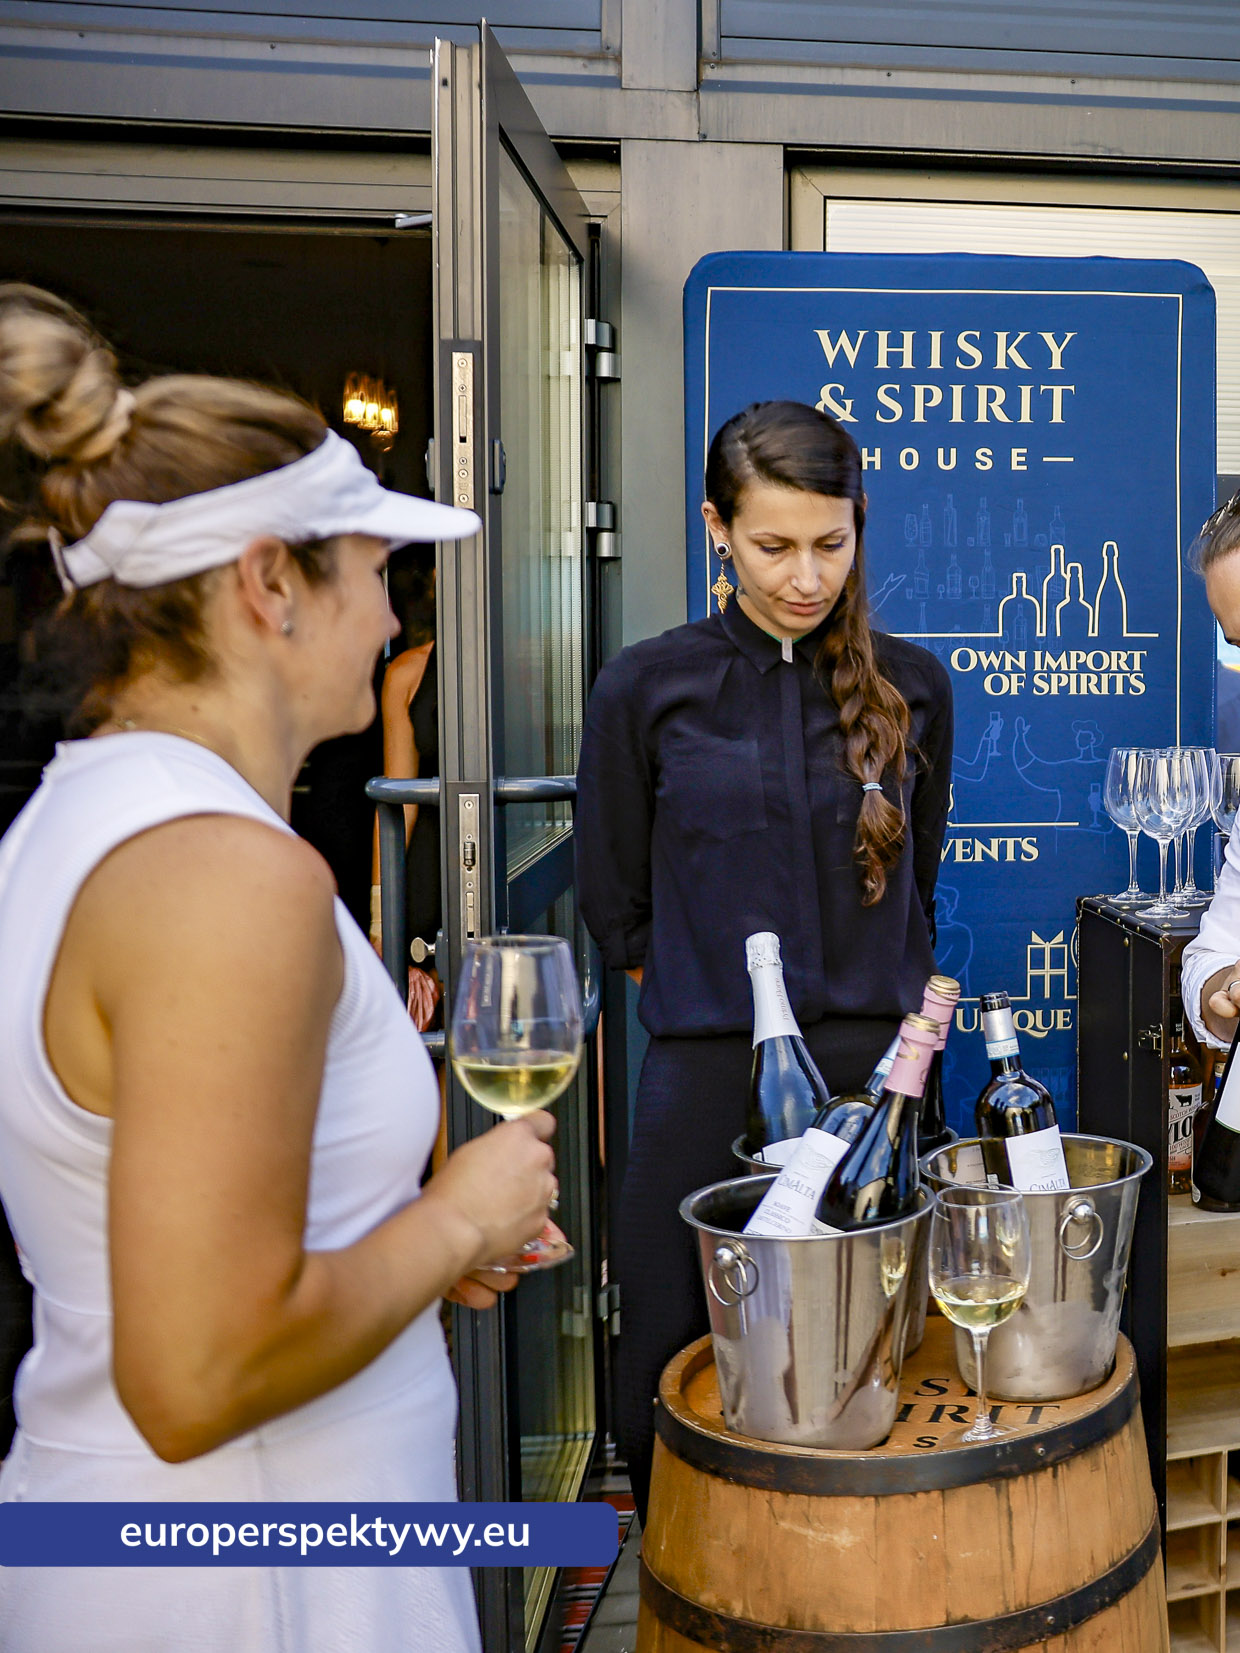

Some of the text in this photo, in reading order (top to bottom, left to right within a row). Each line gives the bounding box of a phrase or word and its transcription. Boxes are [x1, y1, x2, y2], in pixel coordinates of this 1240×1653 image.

[812, 329, 1078, 370] WHISKY
[814, 383, 1076, 424] & SPIRIT
[861, 447, 1029, 471] HOUSE
[950, 647, 1147, 672] OWN IMPORT
[983, 672, 1147, 696] OF SPIRITS
